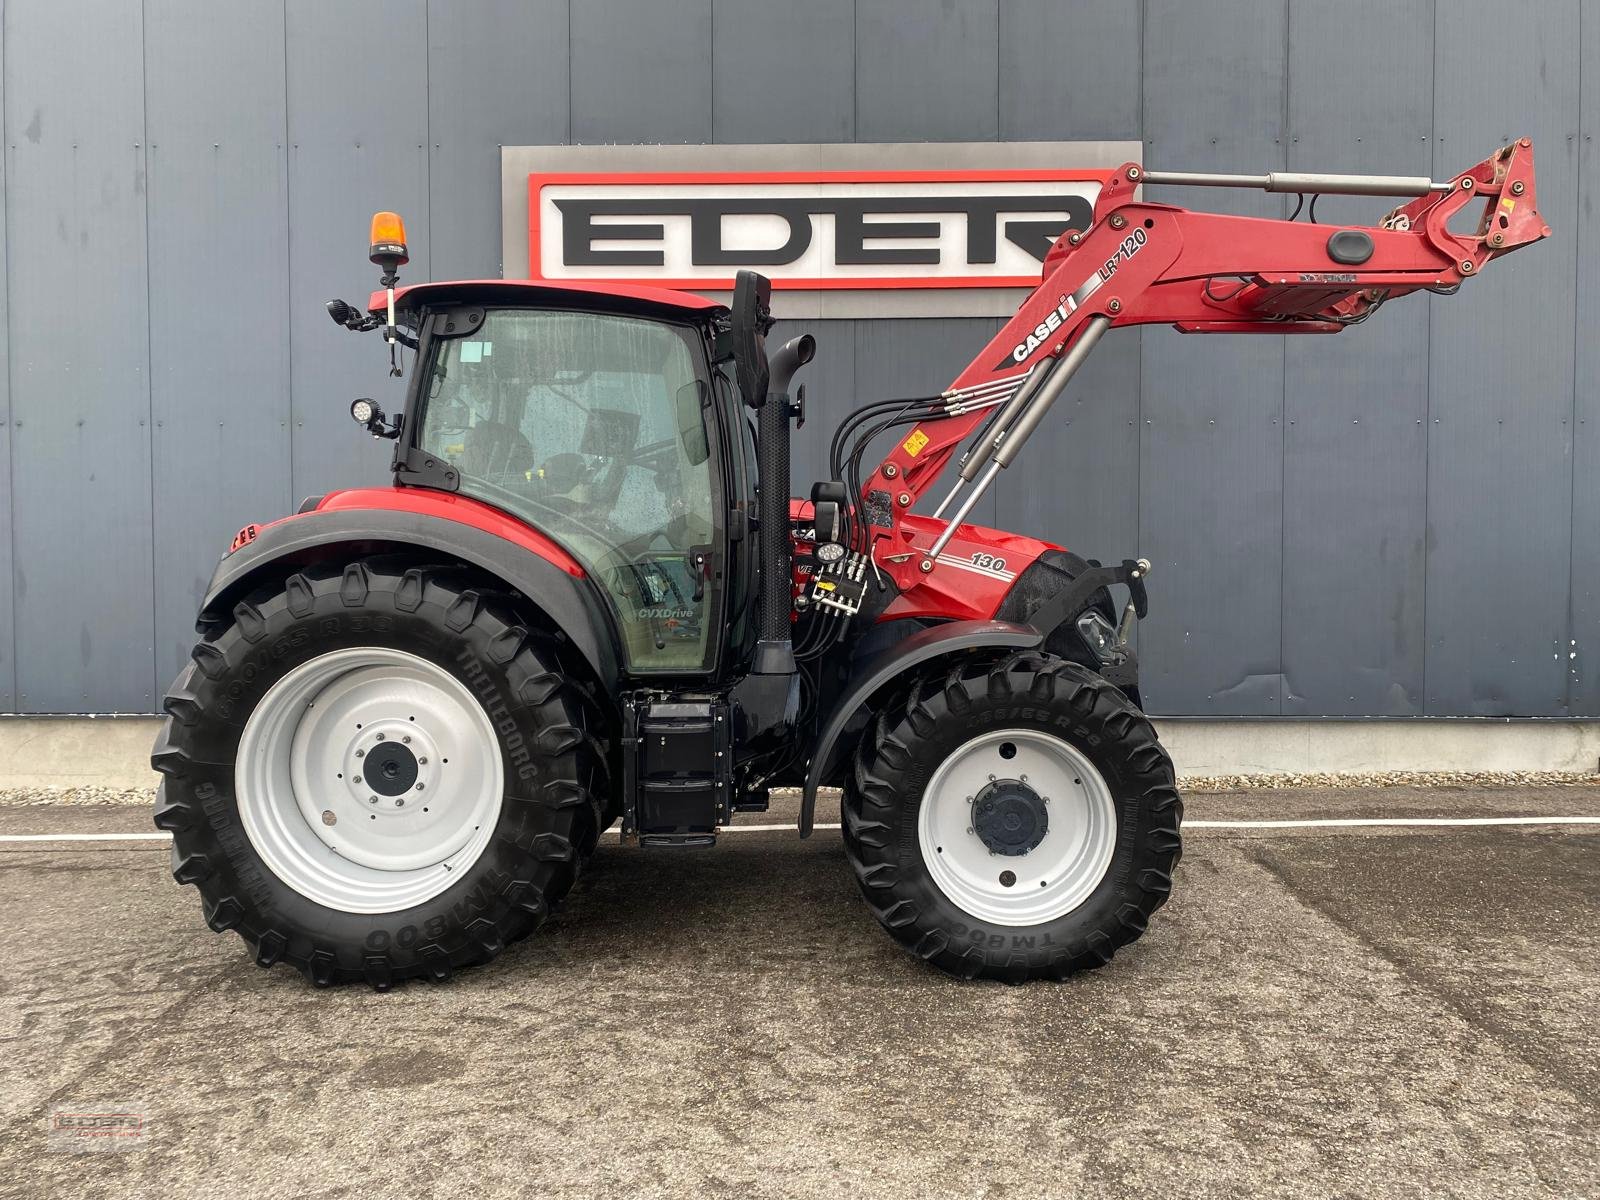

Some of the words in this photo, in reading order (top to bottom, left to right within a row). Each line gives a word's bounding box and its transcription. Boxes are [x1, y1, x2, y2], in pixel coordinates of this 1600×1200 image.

[551, 195, 1094, 266] EDER
[792, 528, 816, 541] CA
[972, 552, 1006, 571] 130
[638, 608, 694, 619] CVXDrive
[455, 641, 539, 781] TRELLEBORG
